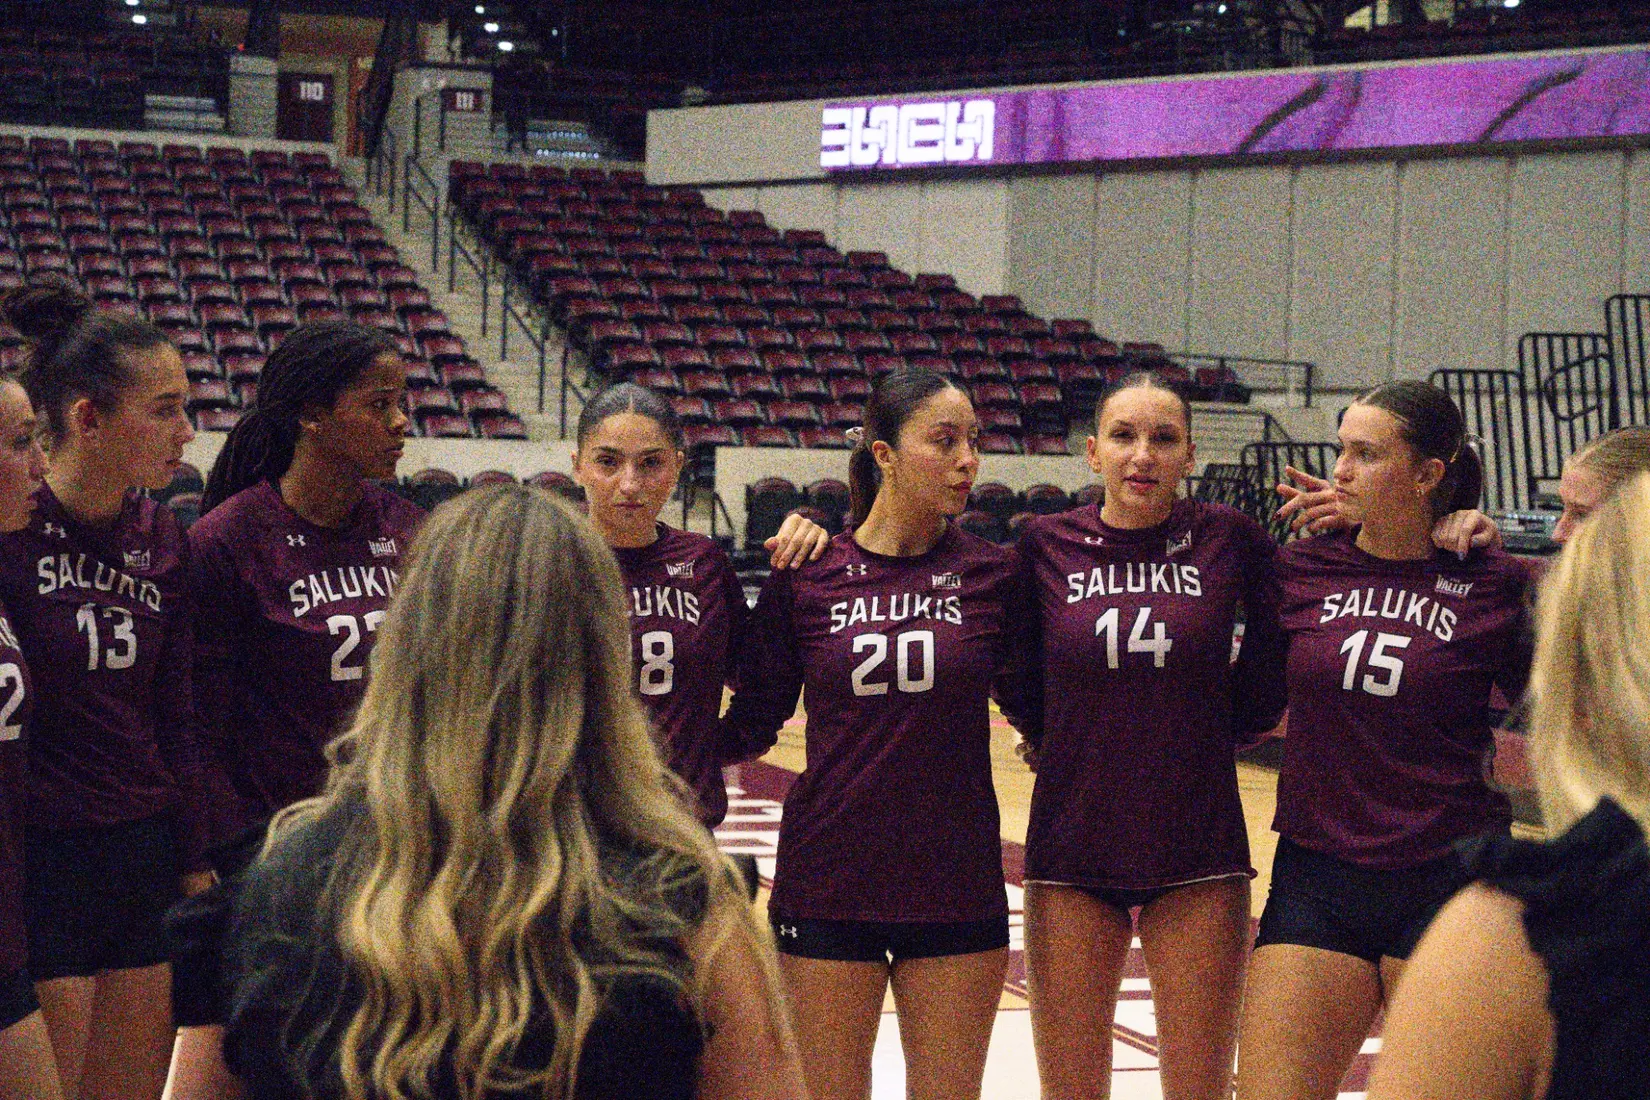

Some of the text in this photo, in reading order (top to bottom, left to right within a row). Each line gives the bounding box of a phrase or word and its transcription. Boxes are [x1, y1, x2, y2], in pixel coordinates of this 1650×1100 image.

[289, 566, 400, 618] SALUKI
[630, 584, 701, 627] UKIS
[1067, 562, 1202, 603] SALUKIS
[1435, 574, 1474, 598] VALLEY
[76, 602, 138, 670] 13
[829, 593, 963, 634] SALUKIS
[1095, 607, 1173, 669] 14
[1319, 587, 1458, 642] SALUKIS
[629, 630, 675, 696] 8
[851, 630, 935, 697] 20
[1339, 629, 1412, 697] 15
